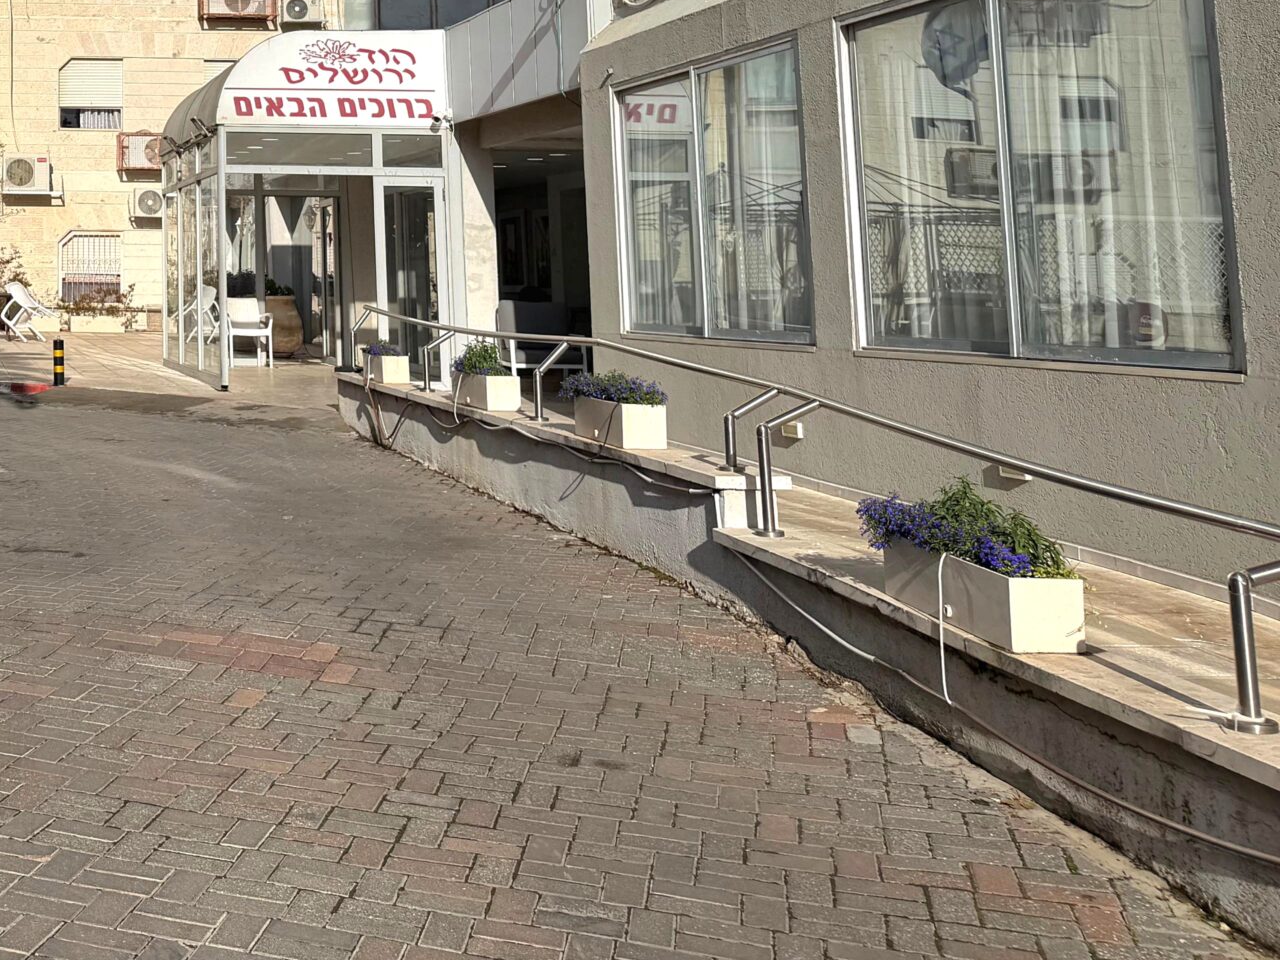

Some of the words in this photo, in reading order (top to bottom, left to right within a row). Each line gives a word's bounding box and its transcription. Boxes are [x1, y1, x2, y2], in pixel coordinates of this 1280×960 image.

[356, 48, 416, 65] הוד
[279, 62, 416, 85] ירושלים
[233, 96, 327, 118] הבאים
[337, 97, 434, 119] ברוכים
